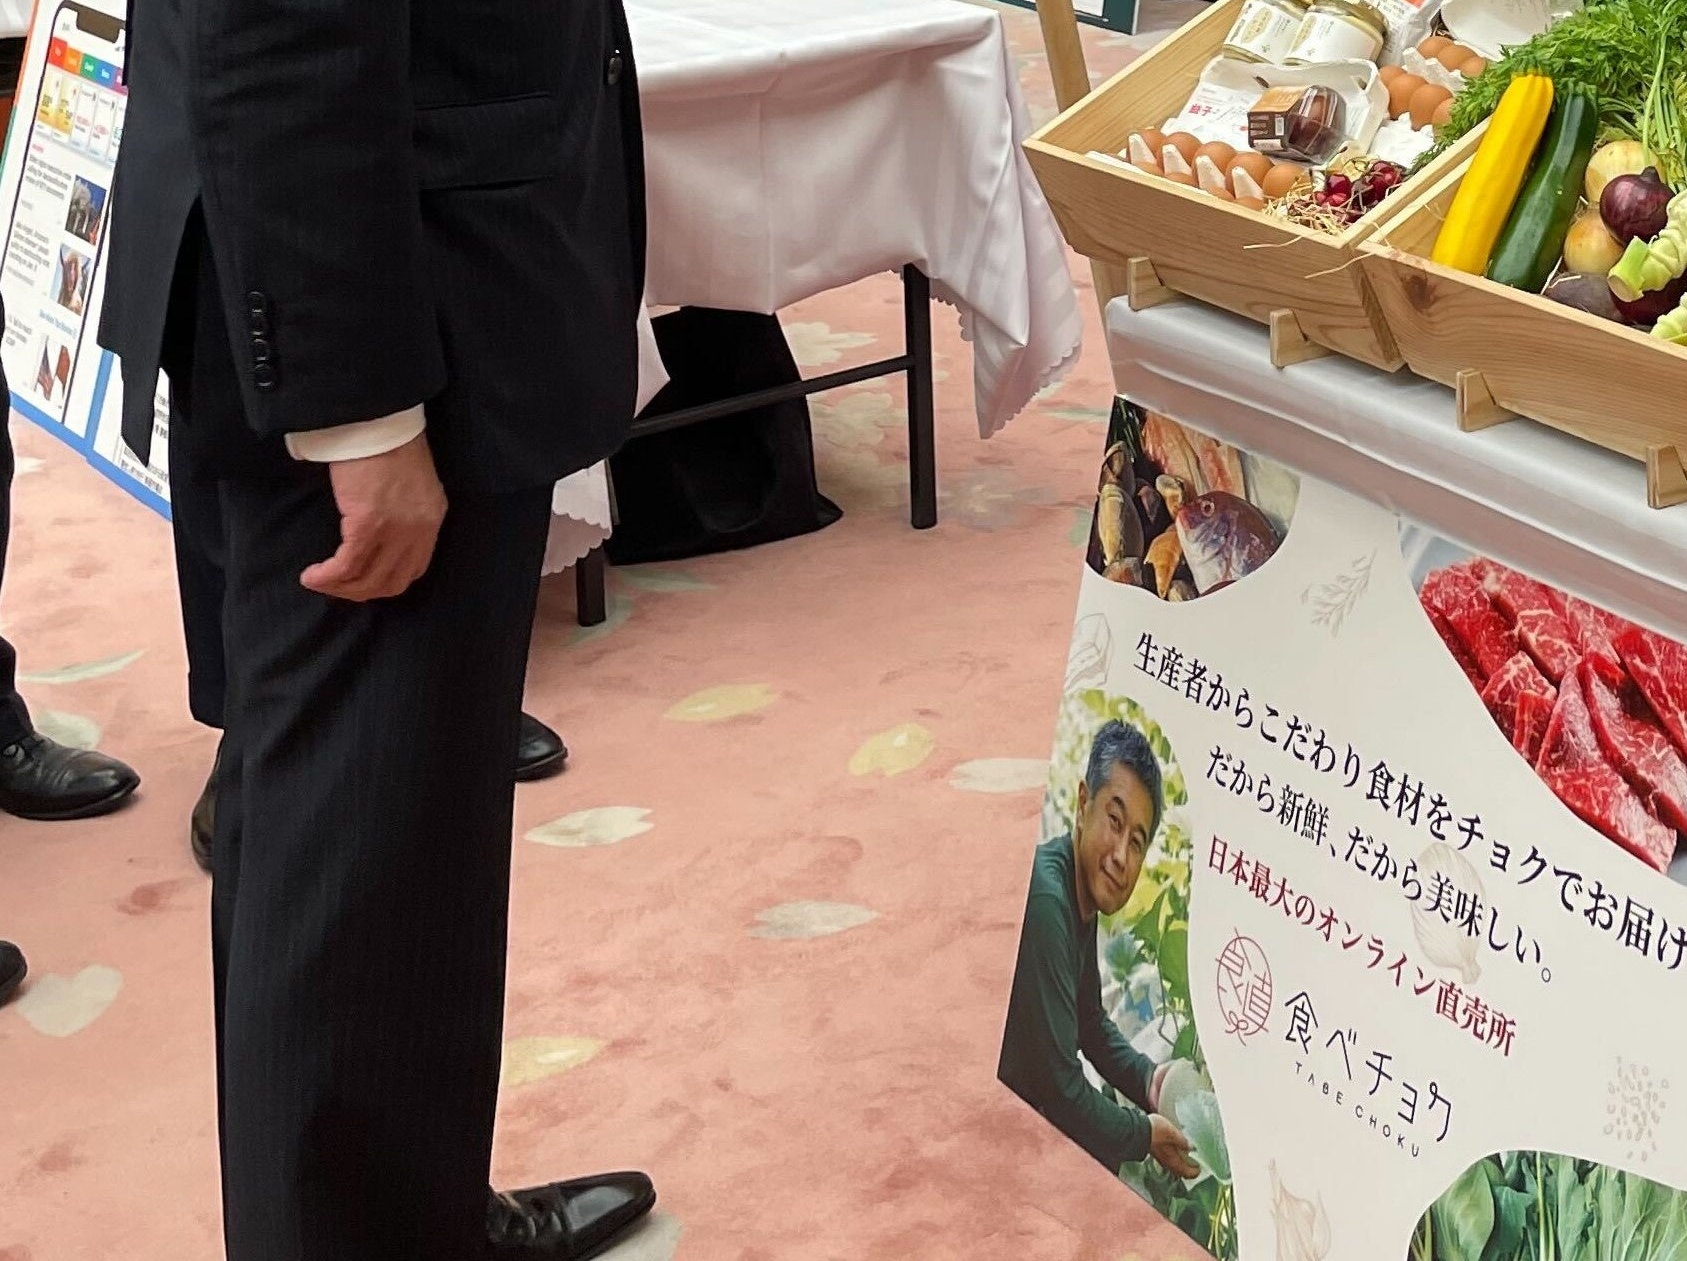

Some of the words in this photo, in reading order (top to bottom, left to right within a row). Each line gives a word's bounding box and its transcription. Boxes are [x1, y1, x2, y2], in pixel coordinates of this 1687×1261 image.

[1206, 744, 1552, 985] だから新鮮、だから美味しい。
[1206, 834, 1517, 1058] 日本最大のオンライン直売所
[1285, 991, 1451, 1142] 食べチョク
[1295, 1060, 1344, 1106] TABE
[1354, 1105, 1420, 1158] CHOKU
